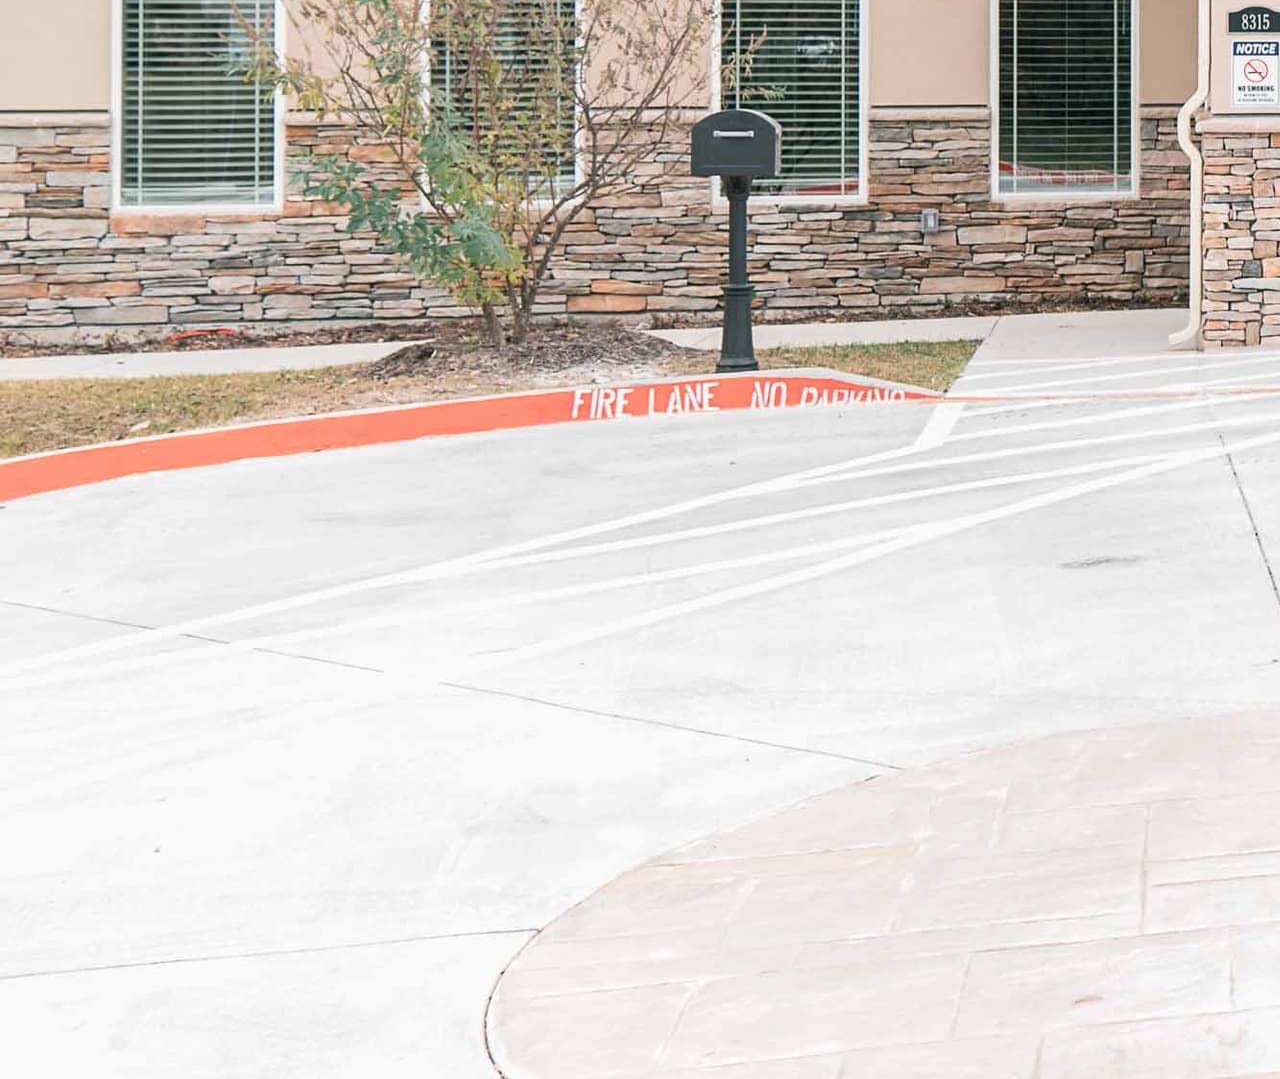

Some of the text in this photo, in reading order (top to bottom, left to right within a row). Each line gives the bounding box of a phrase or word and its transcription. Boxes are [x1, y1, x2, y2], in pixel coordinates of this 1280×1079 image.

[1241, 14, 1270, 30] 8315
[1235, 43, 1277, 55] NOTICE
[571, 387, 634, 419] FIRE
[648, 381, 720, 416] LANE
[750, 380, 788, 409] NO
